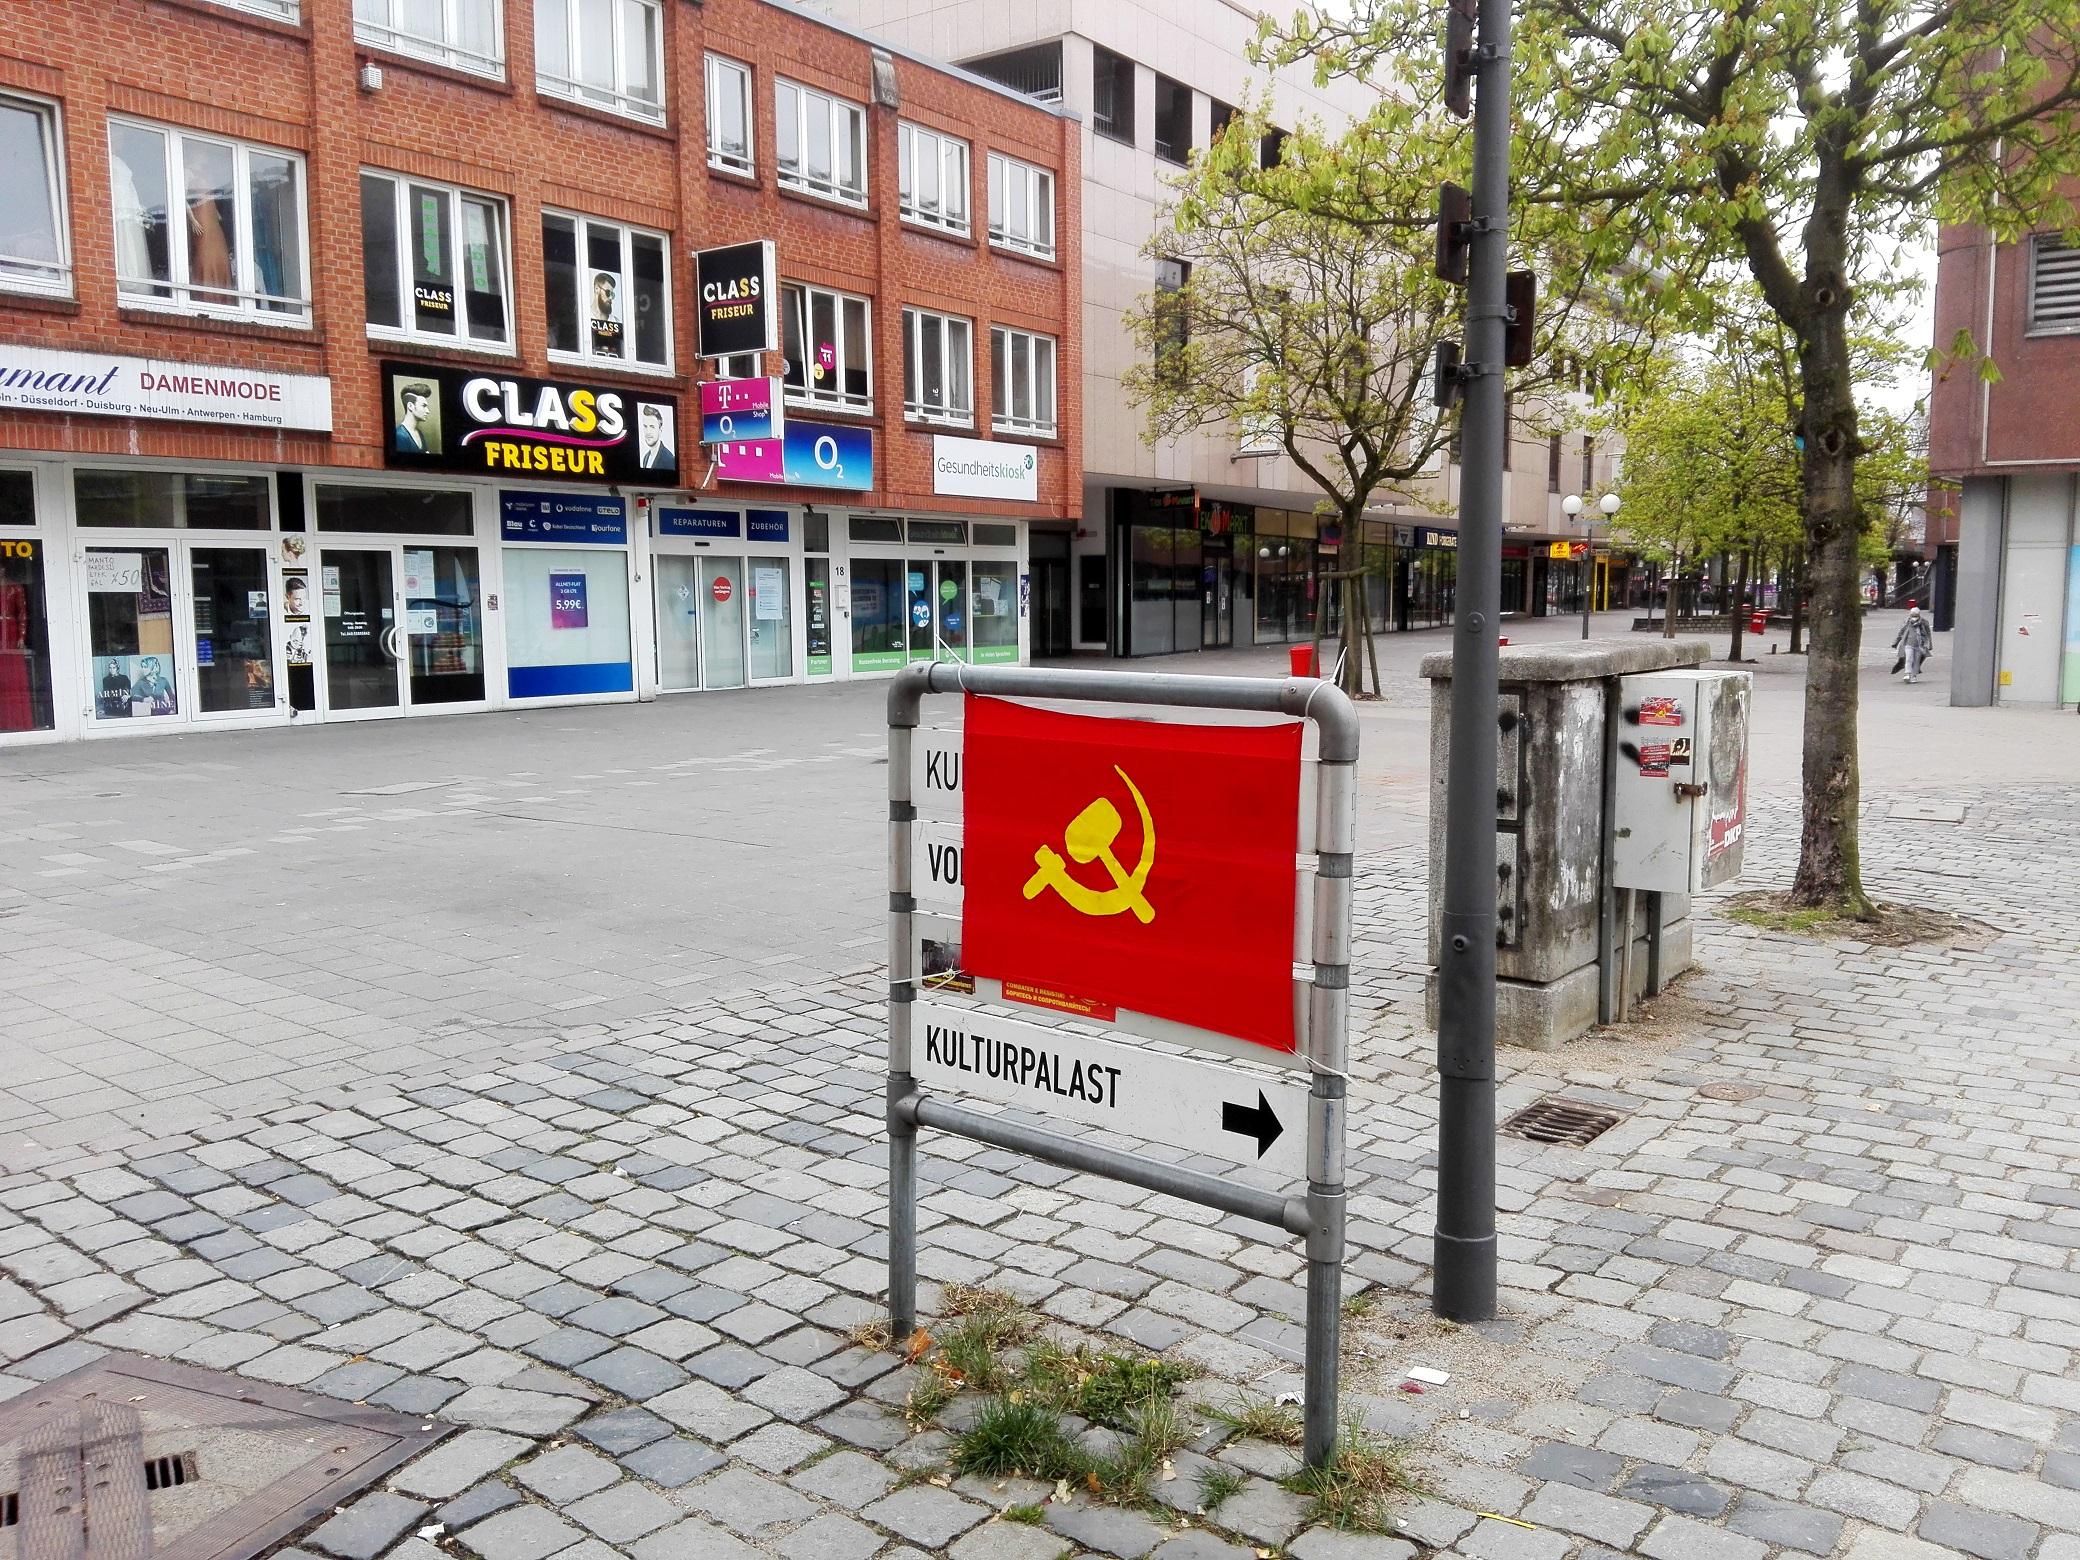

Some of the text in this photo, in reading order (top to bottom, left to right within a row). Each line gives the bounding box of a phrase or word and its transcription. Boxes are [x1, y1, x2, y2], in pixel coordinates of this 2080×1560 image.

[415, 287, 452, 302] CLASS
[703, 275, 760, 303] CLASS
[420, 299, 449, 310] FRISEUR
[711, 303, 754, 321] FRISEUR
[591, 320, 619, 333] CLASS
[140, 372, 282, 402] DAMENMODE
[21, 394, 78, 408] Düsseldorf
[86, 399, 131, 413] Duisburg
[139, 404, 180, 415] Neu-Ulm
[186, 407, 236, 420] Antwerpen
[242, 412, 283, 425] Hamburg
[462, 378, 626, 436] CLASS
[485, 441, 605, 475] FRISEUR
[937, 456, 1026, 481] Gesundheitskiosk
[565, 505, 592, 513] vodafone
[506, 520, 523, 528] Blau
[673, 517, 727, 528] REPARATUREN
[751, 521, 784, 532] ZUBEHÖR
[835, 566, 845, 576] 18
[556, 599, 582, 611] 5,99€
[926, 749, 964, 792] KU
[1724, 823, 1742, 848] DKP
[926, 1024, 1122, 1108] KULTURPALAST
